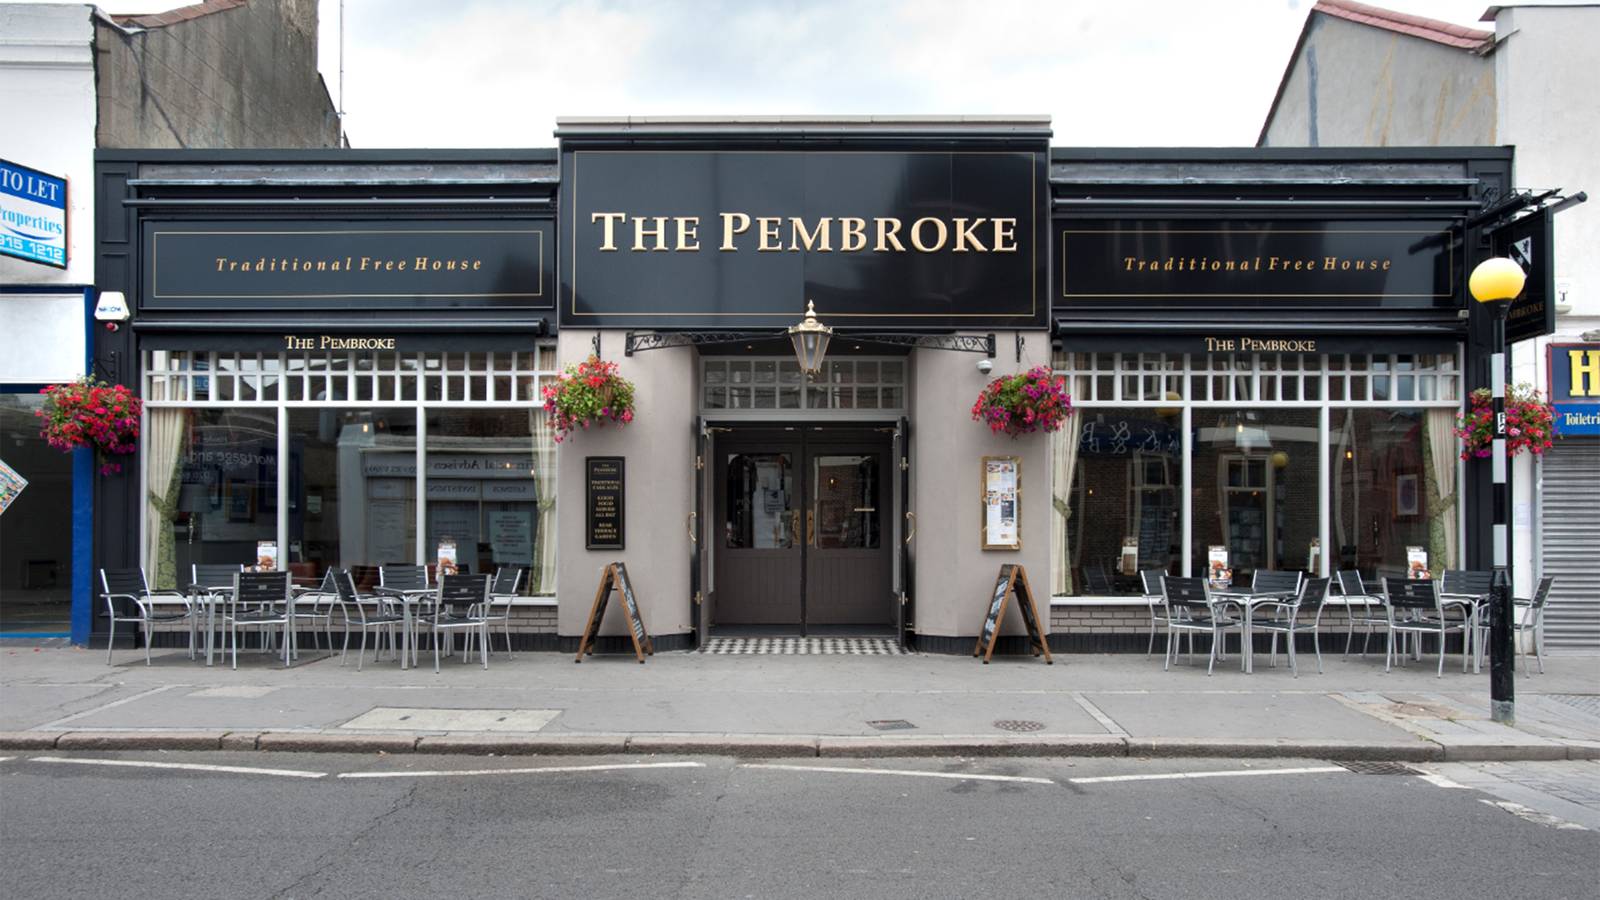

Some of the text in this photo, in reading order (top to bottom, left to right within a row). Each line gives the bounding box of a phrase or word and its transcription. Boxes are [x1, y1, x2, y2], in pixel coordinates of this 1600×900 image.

[0, 168, 59, 201] TO LET
[0, 206, 63, 234] roperties
[592, 212, 1018, 252] THE PEMBROKE
[29, 242, 63, 260] 1212
[216, 257, 482, 272] Traditional Free House
[1124, 257, 1391, 272] Traditional Free House
[284, 335, 396, 349] THE PEMBROKE
[1204, 337, 1317, 352] THE PEMBROKE
